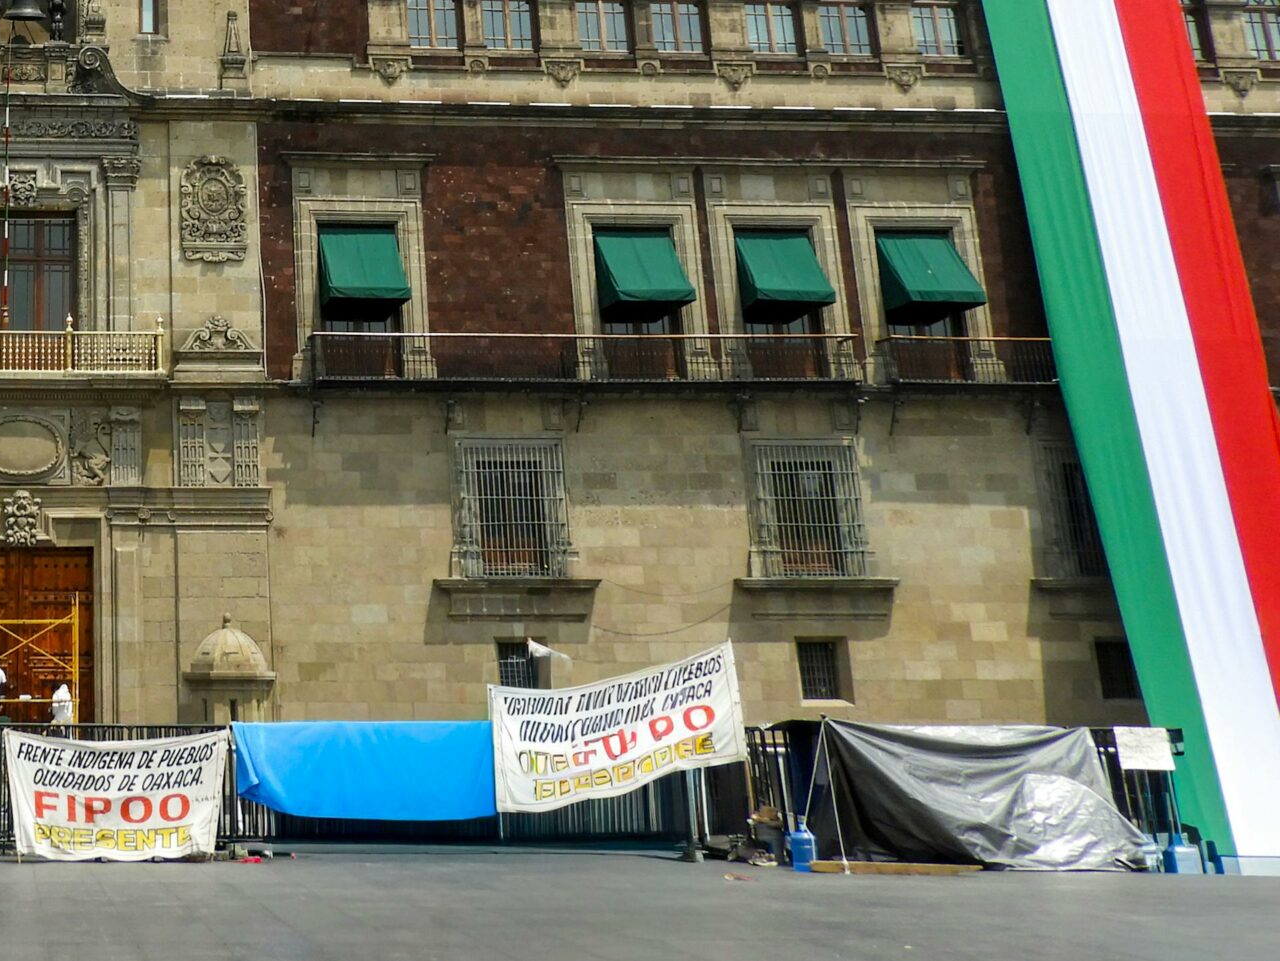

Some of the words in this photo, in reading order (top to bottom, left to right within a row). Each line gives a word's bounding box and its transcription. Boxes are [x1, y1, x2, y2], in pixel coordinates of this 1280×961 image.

[16, 742, 65, 767] FRENTE
[67, 749, 135, 769] INDIGENA
[137, 750, 155, 769] DE
[157, 741, 217, 768] PUEBLOS
[117, 774, 138, 792] DE
[142, 766, 204, 791] OAXACA.
[34, 791, 190, 824] FIPOO
[34, 823, 193, 851] PRESENTE
